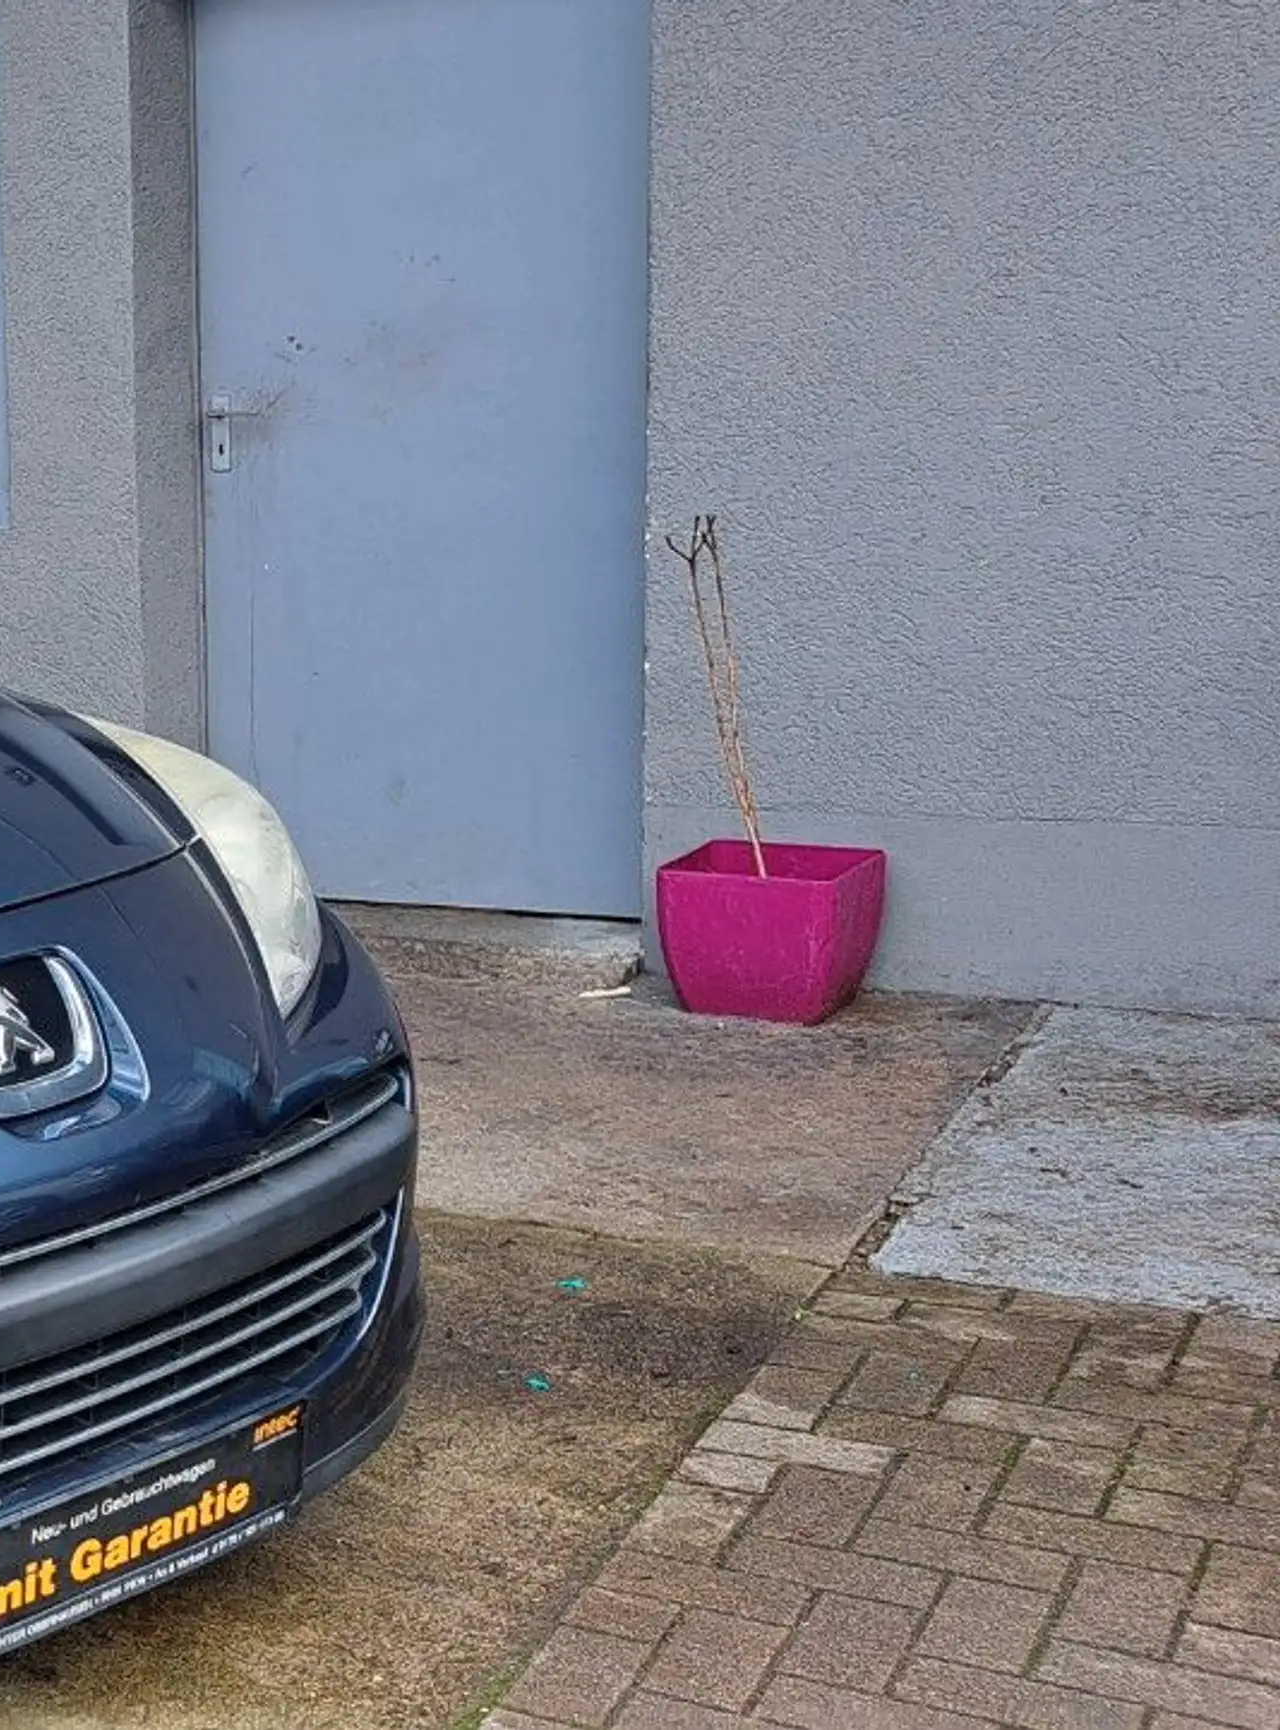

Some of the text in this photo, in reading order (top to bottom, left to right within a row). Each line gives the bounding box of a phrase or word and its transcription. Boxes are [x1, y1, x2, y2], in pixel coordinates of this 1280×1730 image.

[70, 1504, 99, 1529] und
[101, 1458, 216, 1515] Gebrauchtwagen
[70, 1480, 251, 1582] Garantie
